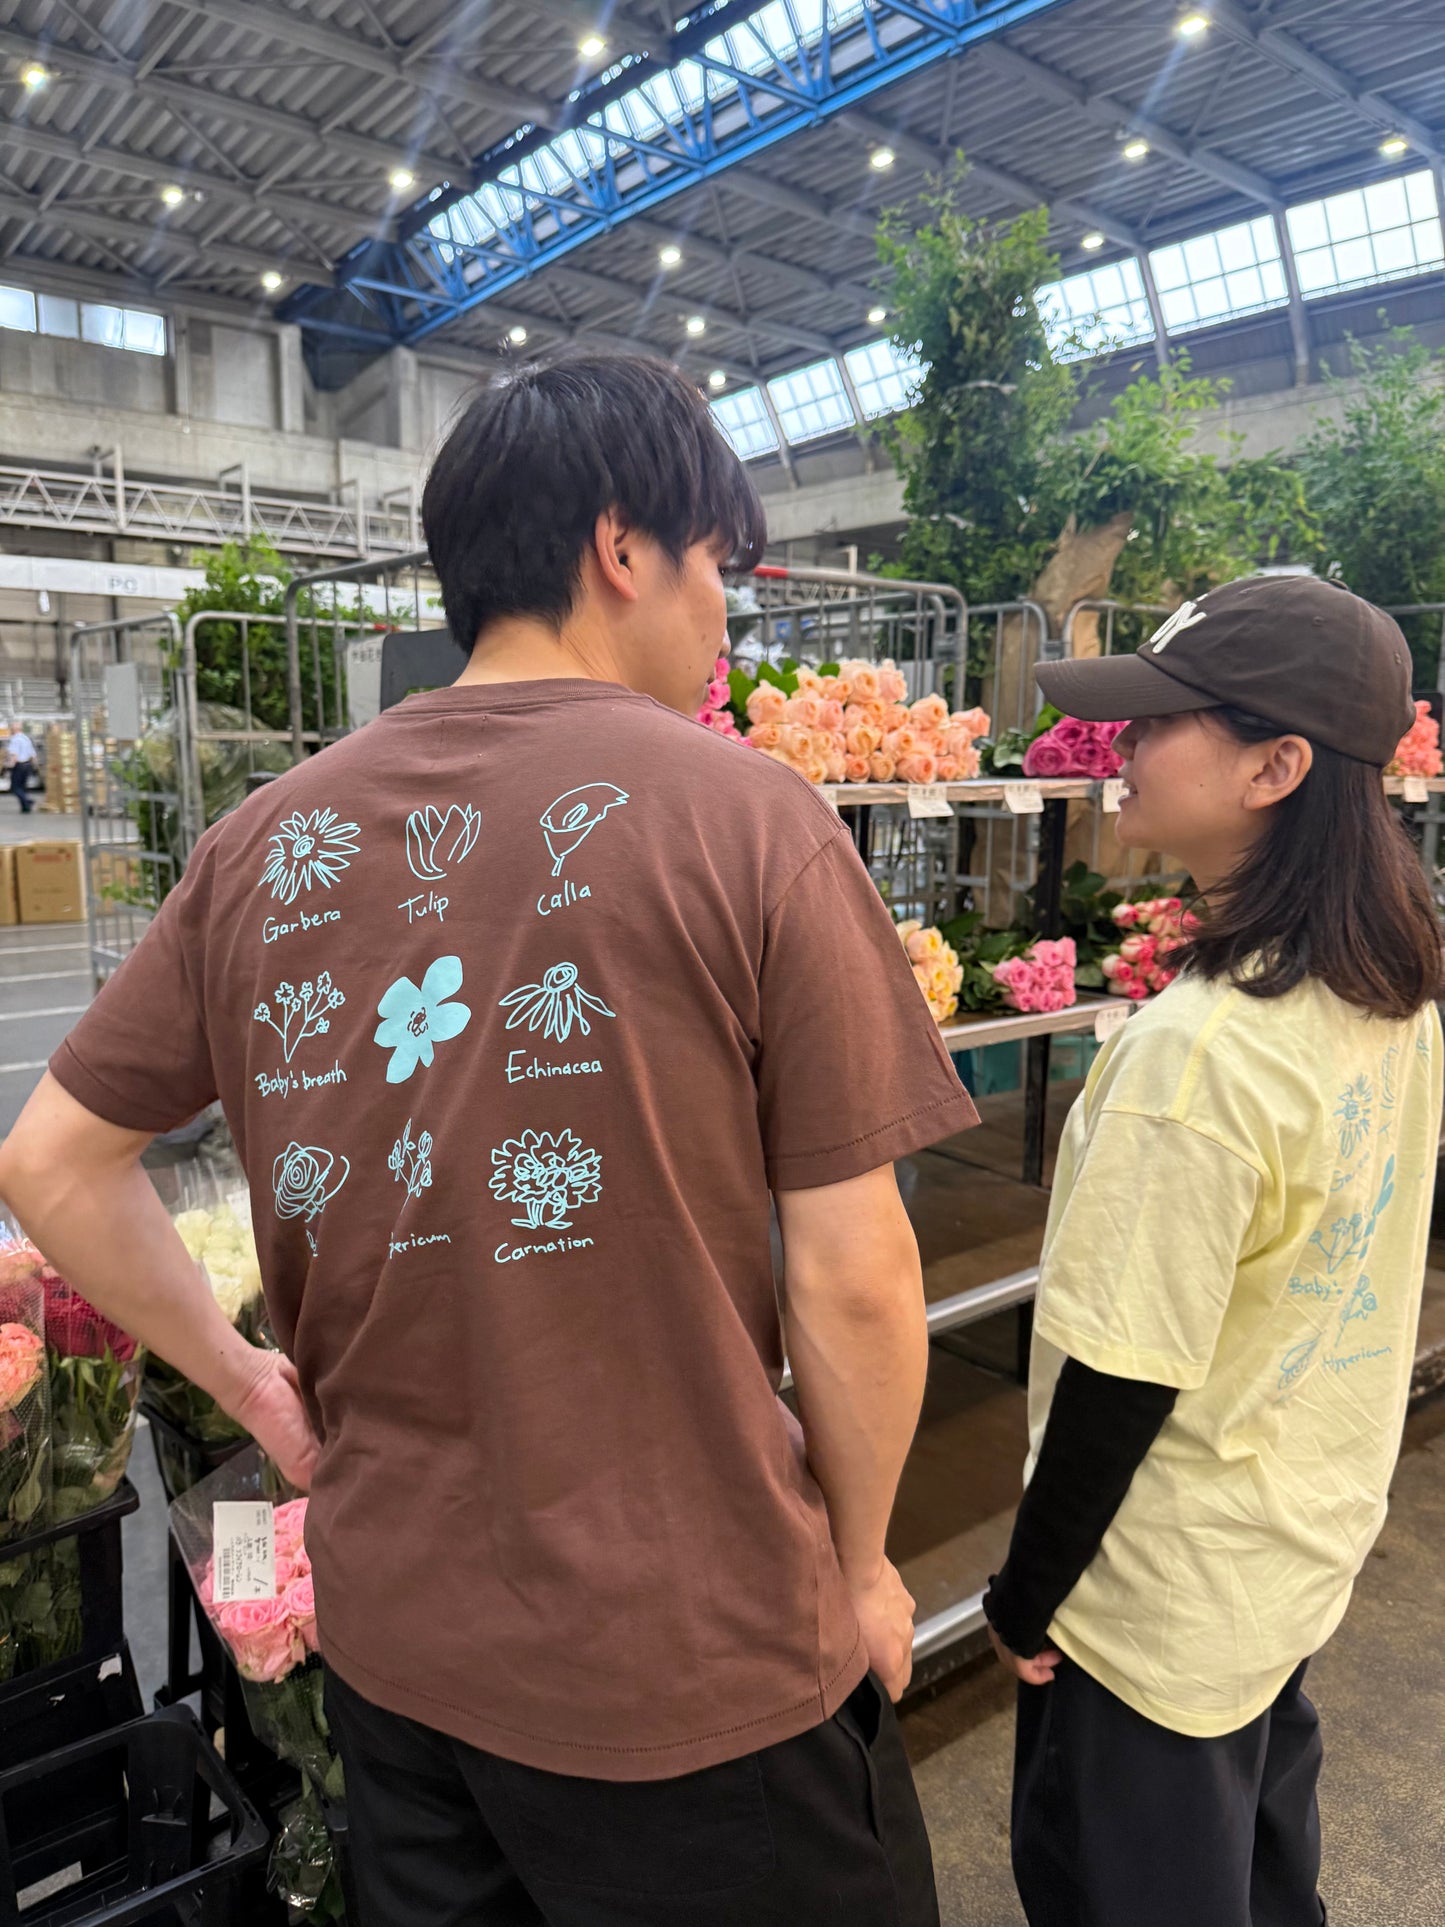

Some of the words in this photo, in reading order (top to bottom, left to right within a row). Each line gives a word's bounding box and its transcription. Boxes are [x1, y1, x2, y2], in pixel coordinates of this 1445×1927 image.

[397, 890, 450, 924] Tulip
[262, 909, 342, 945] Garbera
[254, 1067, 300, 1100] Baby's
[301, 1059, 347, 1091] breath
[505, 1048, 604, 1085] Echinacea
[493, 1238, 595, 1265] Carnation
